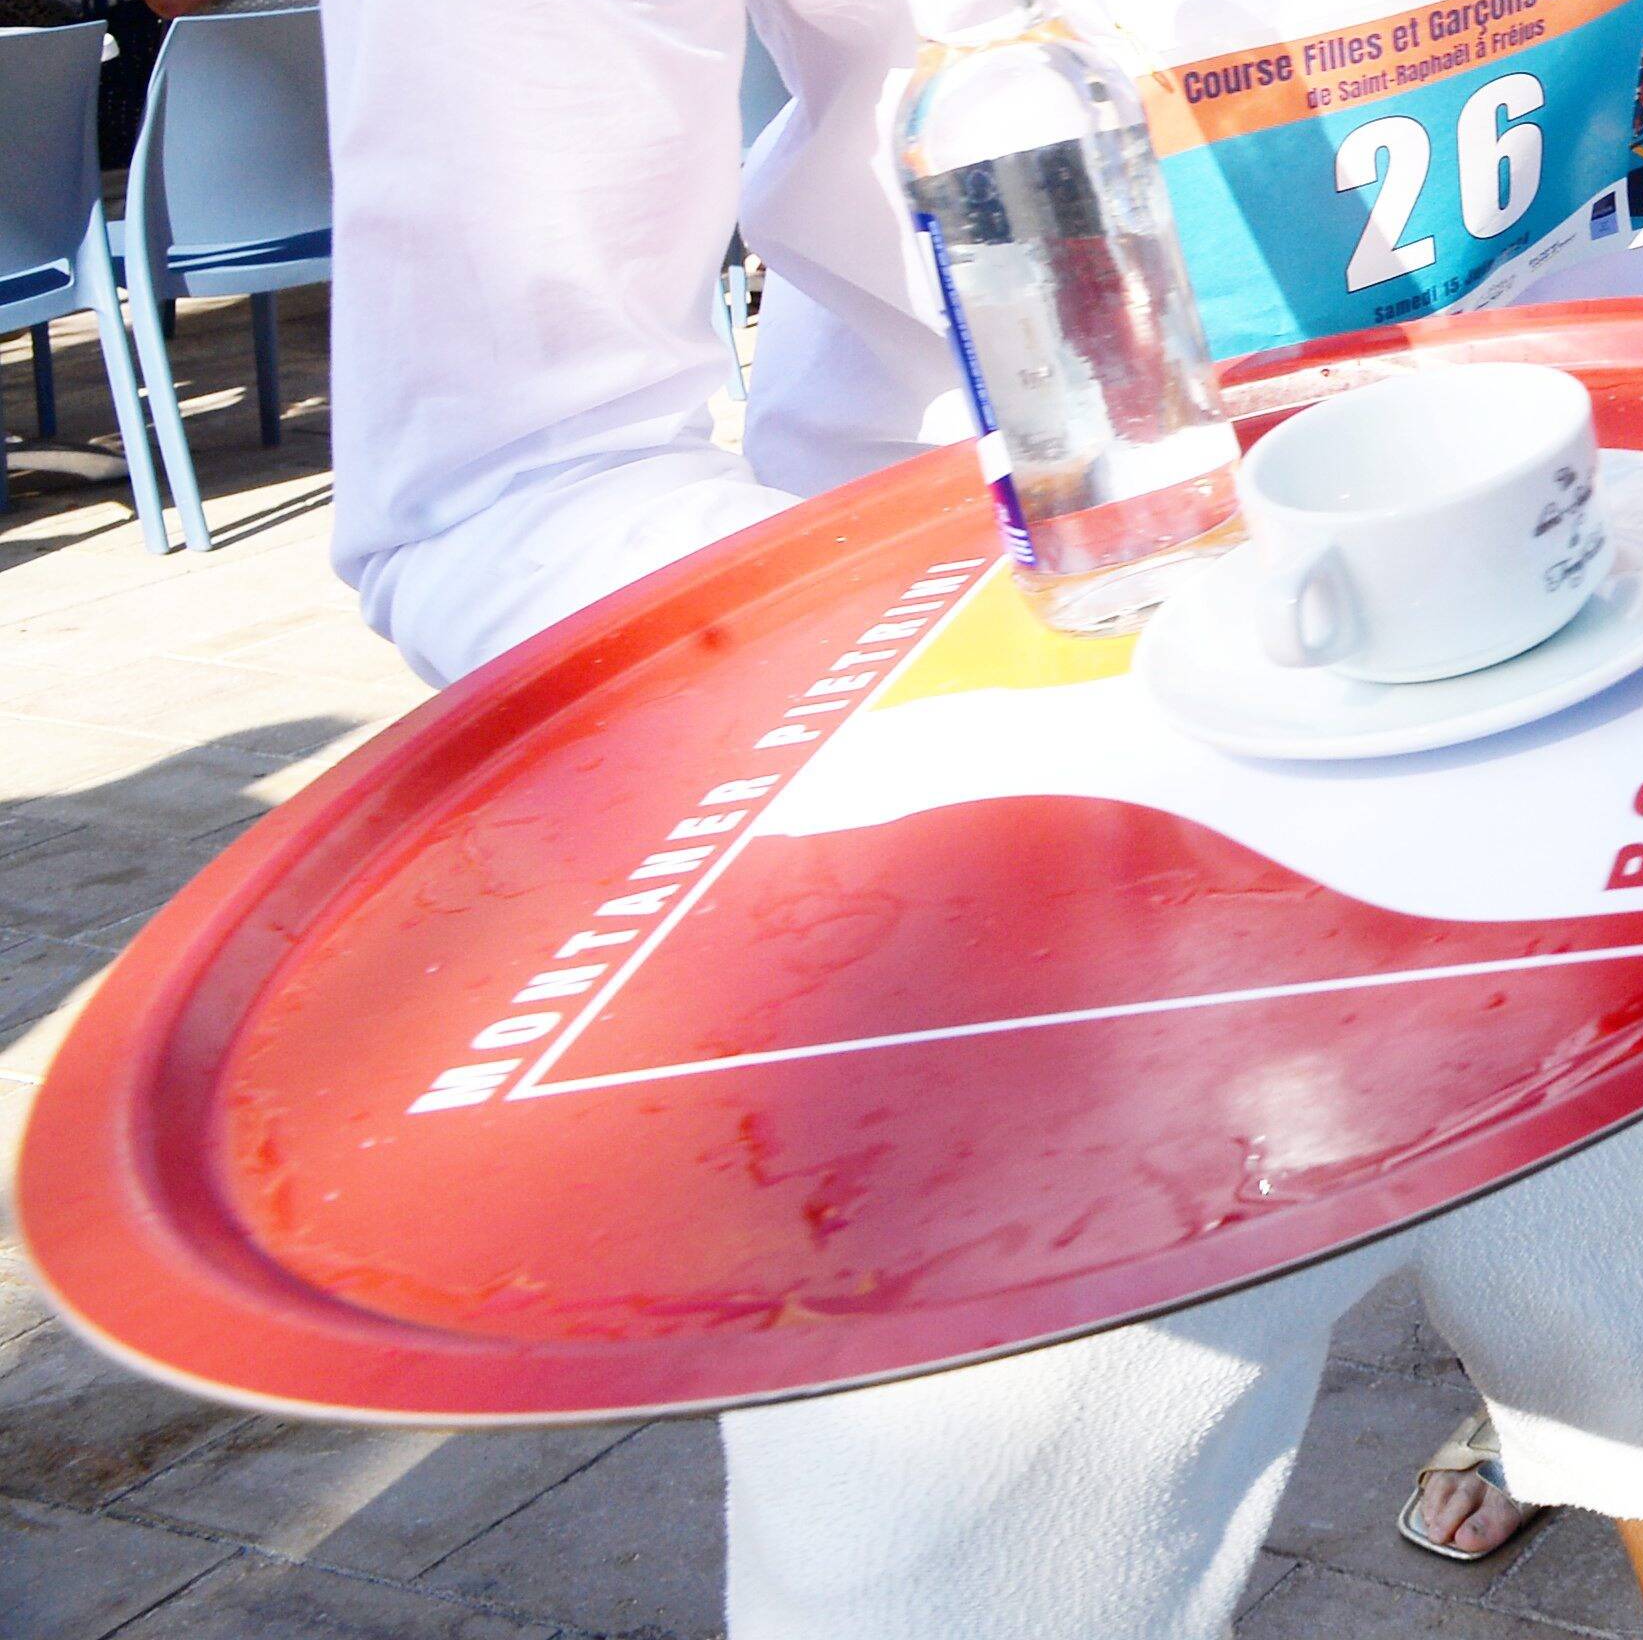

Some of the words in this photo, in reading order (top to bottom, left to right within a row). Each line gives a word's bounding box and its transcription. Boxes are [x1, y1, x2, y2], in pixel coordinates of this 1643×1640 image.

[1183, 52, 1293, 104] Course
[1303, 31, 1383, 75] Filles
[1393, 20, 1420, 52] et
[1306, 85, 1332, 110] de
[1338, 45, 1470, 102] Saint-Raphaël
[1475, 37, 1486, 60] à
[1492, 17, 1546, 56] Fréjus
[1334, 71, 1546, 293] 26
[1374, 285, 1438, 323] Samedi
[404, 773, 781, 1116] MONTANER
[753, 557, 986, 750] PIETRINI
